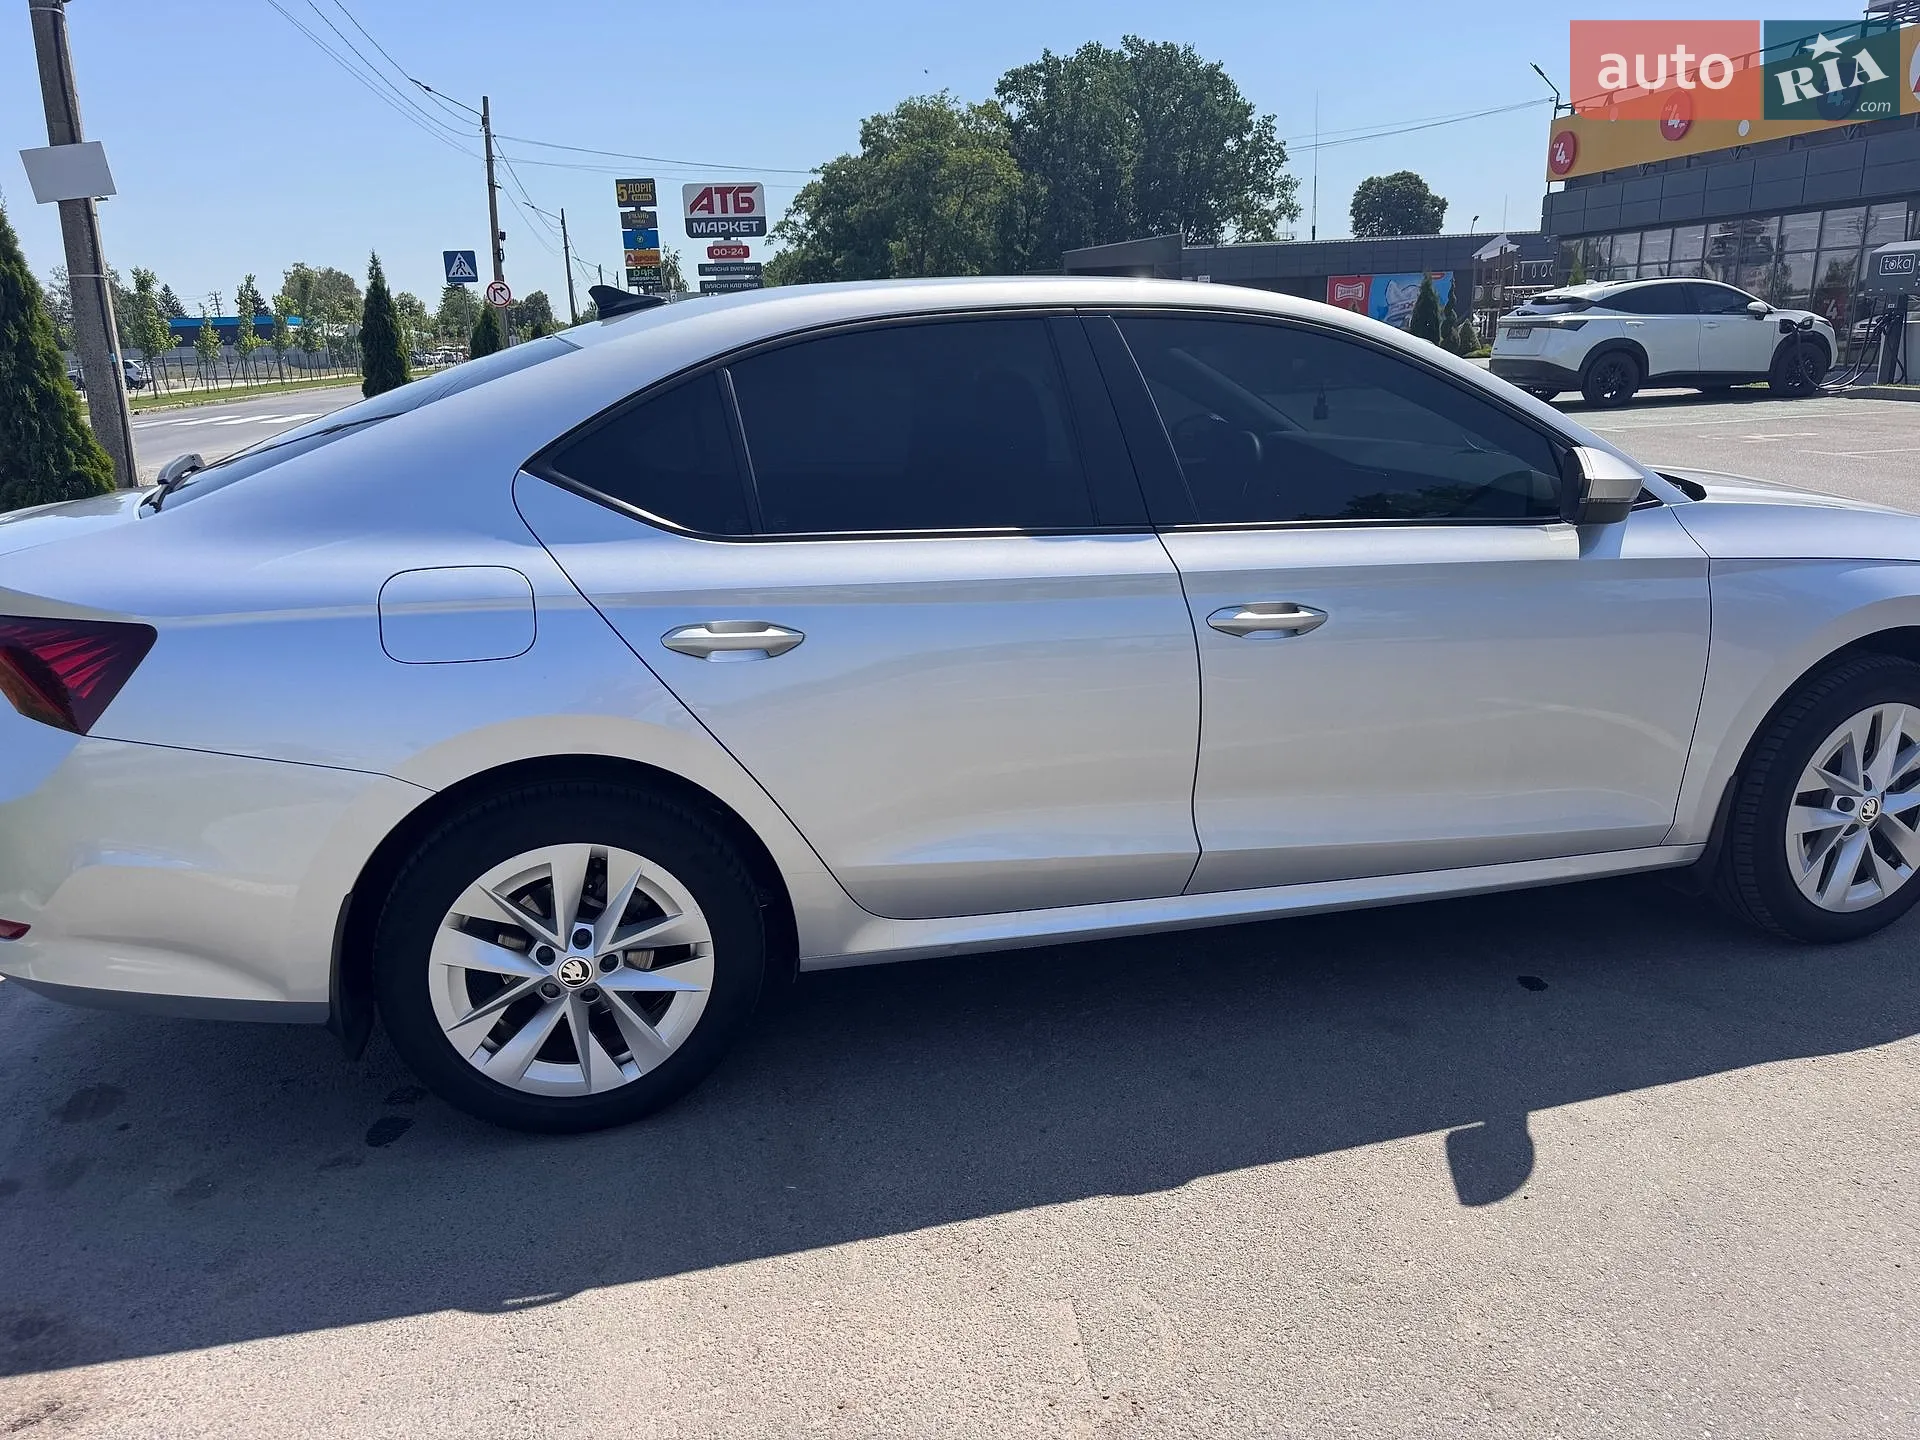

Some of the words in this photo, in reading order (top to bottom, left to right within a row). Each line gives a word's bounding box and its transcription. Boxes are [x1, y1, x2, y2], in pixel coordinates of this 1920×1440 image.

[1555, 142, 1566, 164] 4
[617, 184, 628, 202] 5
[628, 183, 654, 194] ДОРІГ
[689, 186, 758, 215] АТБ
[692, 220, 760, 234] МАРКЕТ
[713, 248, 744, 256] 00-24
